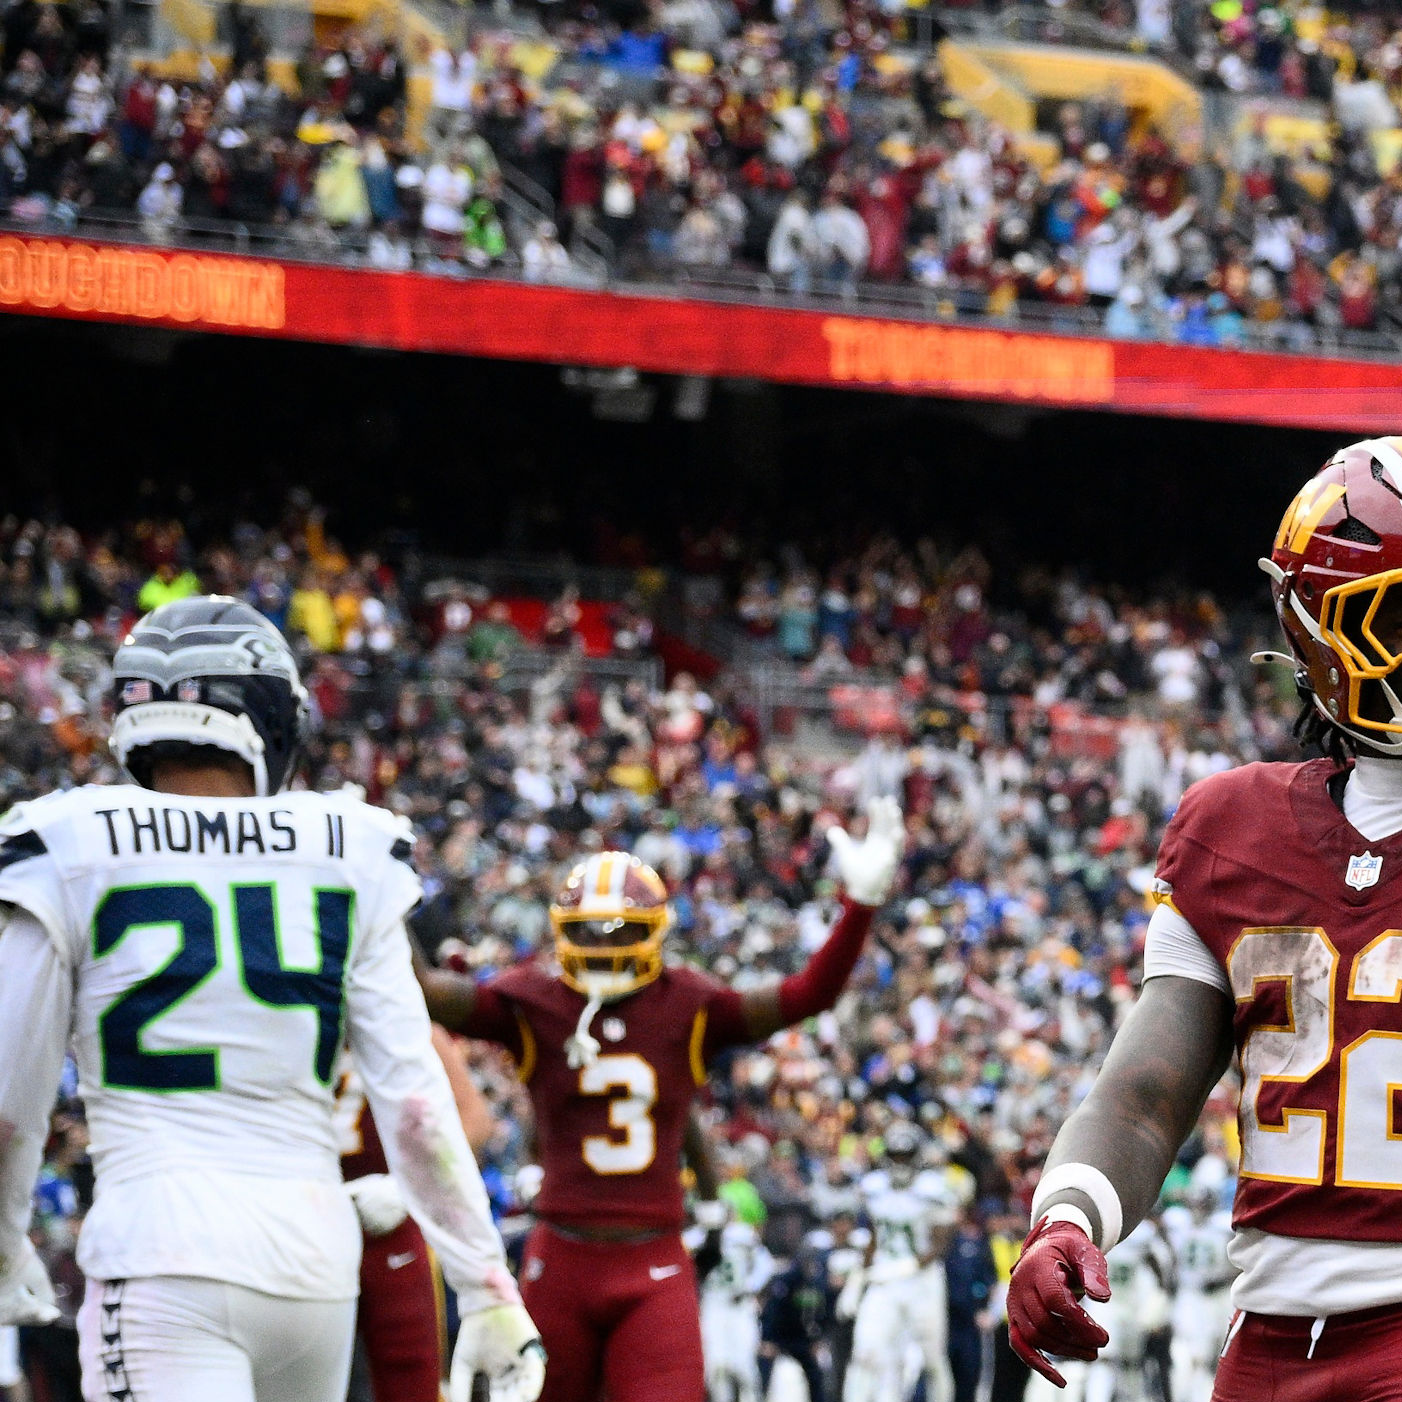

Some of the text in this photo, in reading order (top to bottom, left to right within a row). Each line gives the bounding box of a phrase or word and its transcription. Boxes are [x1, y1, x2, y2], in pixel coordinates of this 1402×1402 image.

[95, 807, 296, 856] THOMAS
[1351, 868, 1371, 882] NFL
[91, 881, 357, 1094] 24
[579, 1053, 658, 1176] 3
